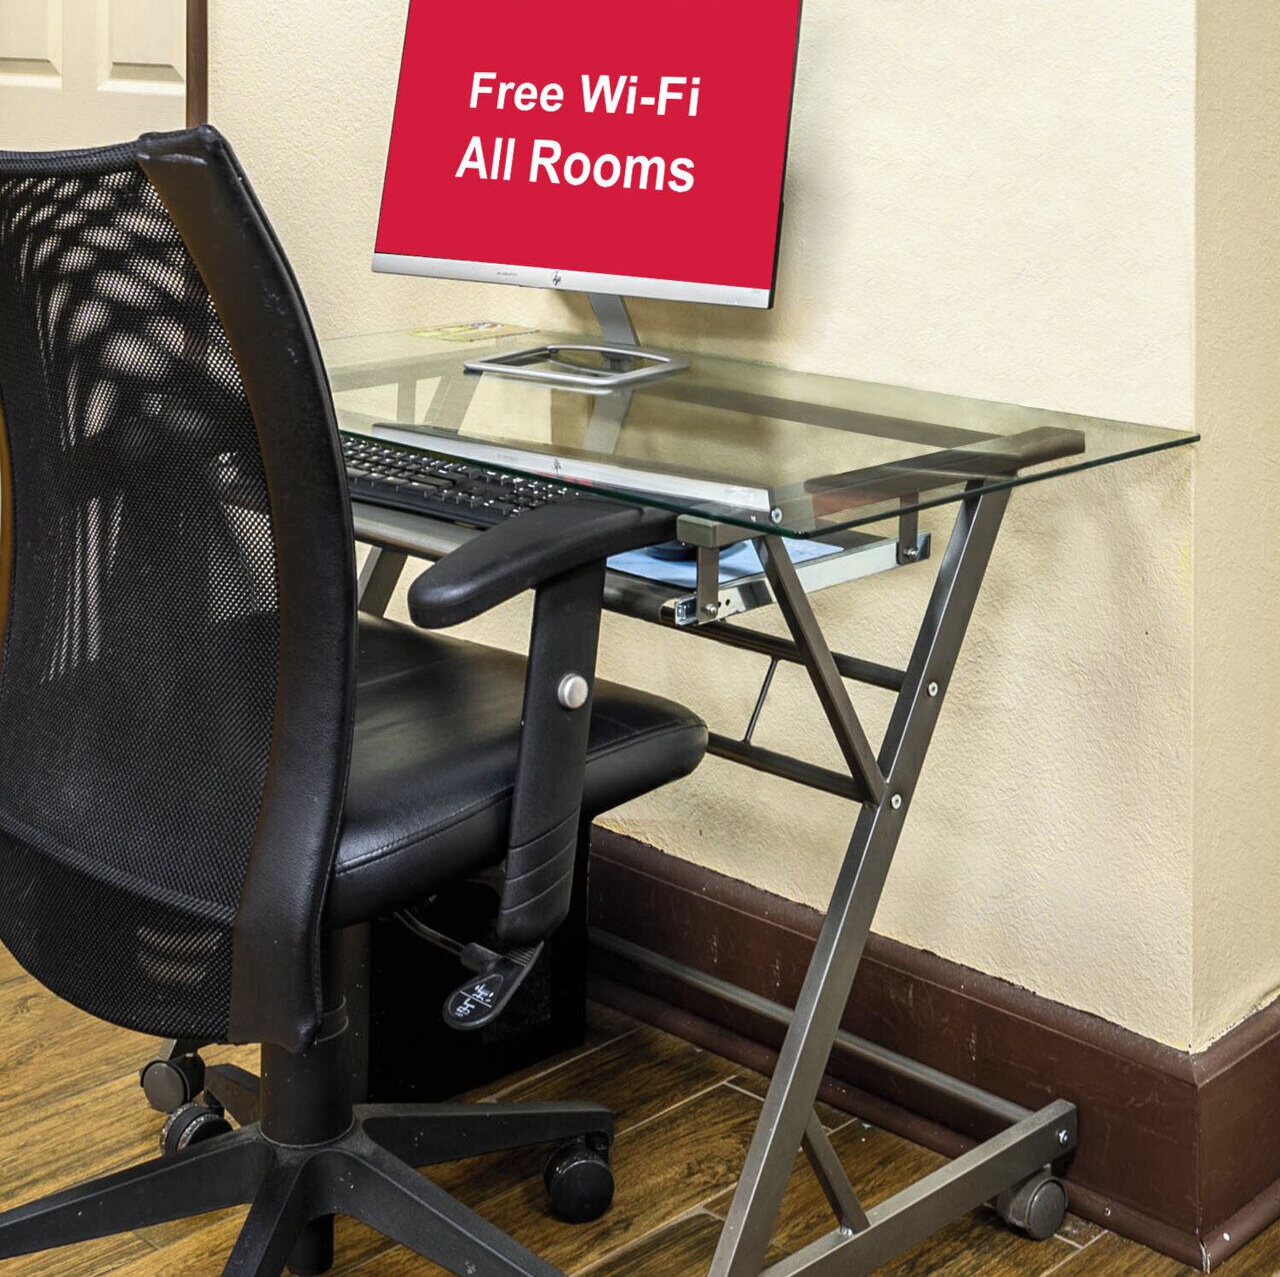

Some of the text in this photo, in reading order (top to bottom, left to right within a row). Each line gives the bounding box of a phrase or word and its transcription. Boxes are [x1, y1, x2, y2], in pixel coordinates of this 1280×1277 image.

[469, 72, 701, 117] Free Wi-Fi
[454, 135, 695, 193] All Rooms
